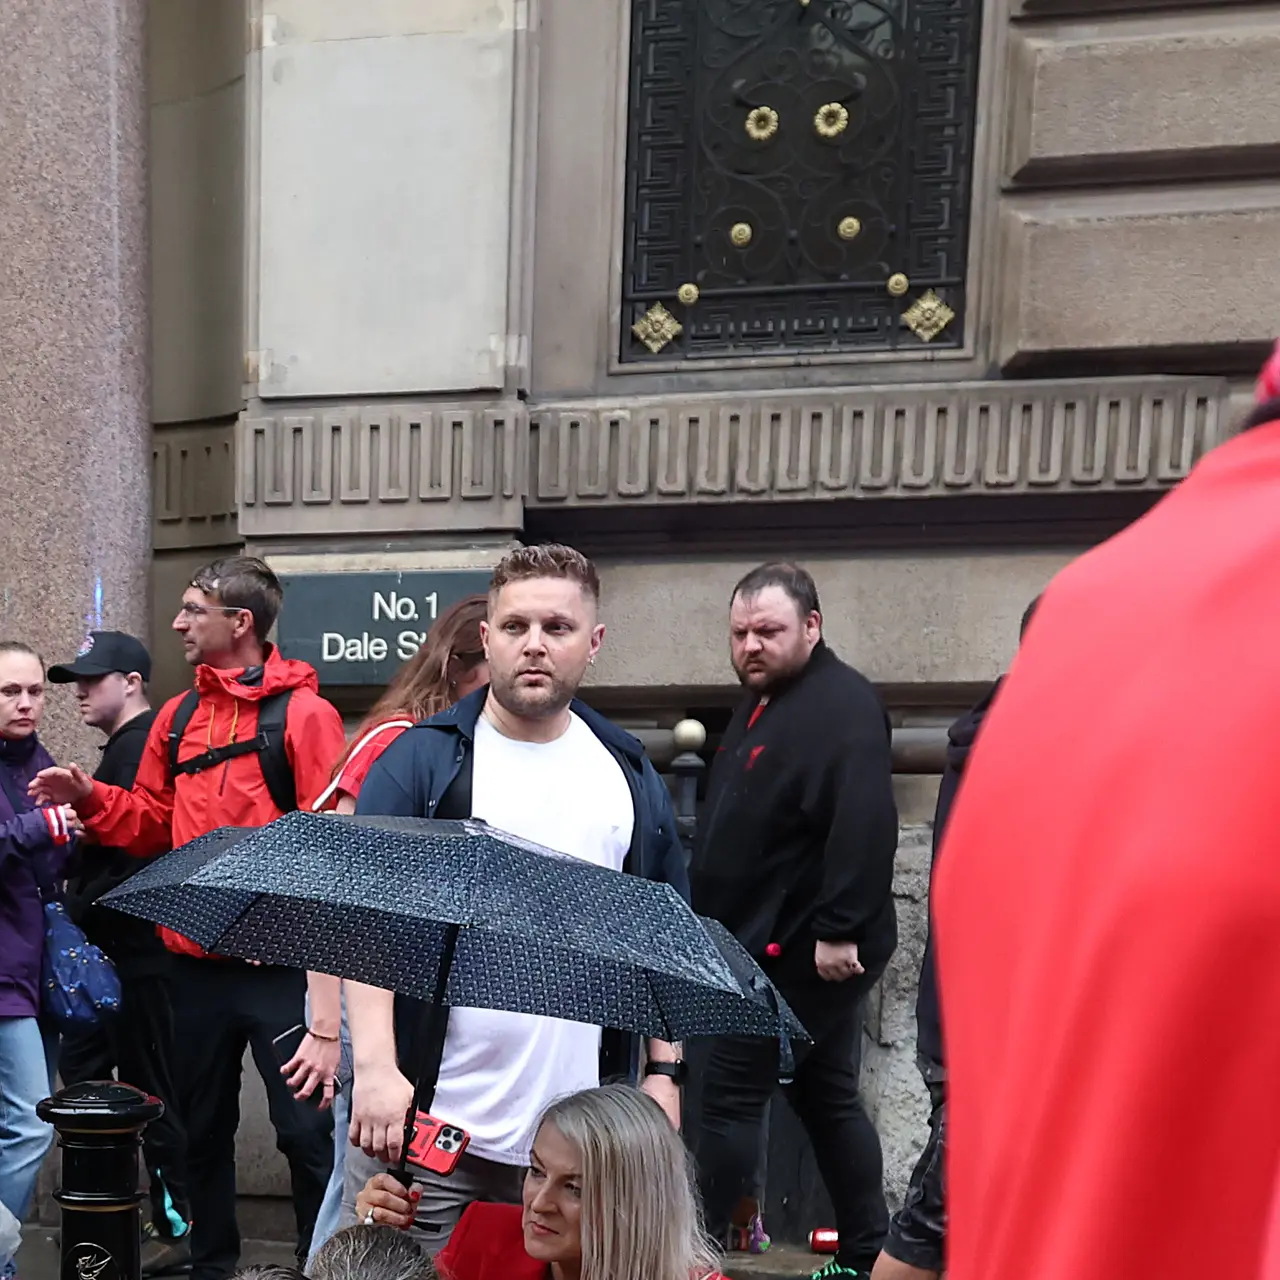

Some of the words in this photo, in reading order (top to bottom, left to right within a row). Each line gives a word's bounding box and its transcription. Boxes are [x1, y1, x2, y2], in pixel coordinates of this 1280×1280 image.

[372, 591, 419, 621] No.
[425, 591, 437, 619] 1
[322, 632, 388, 662] Dale
